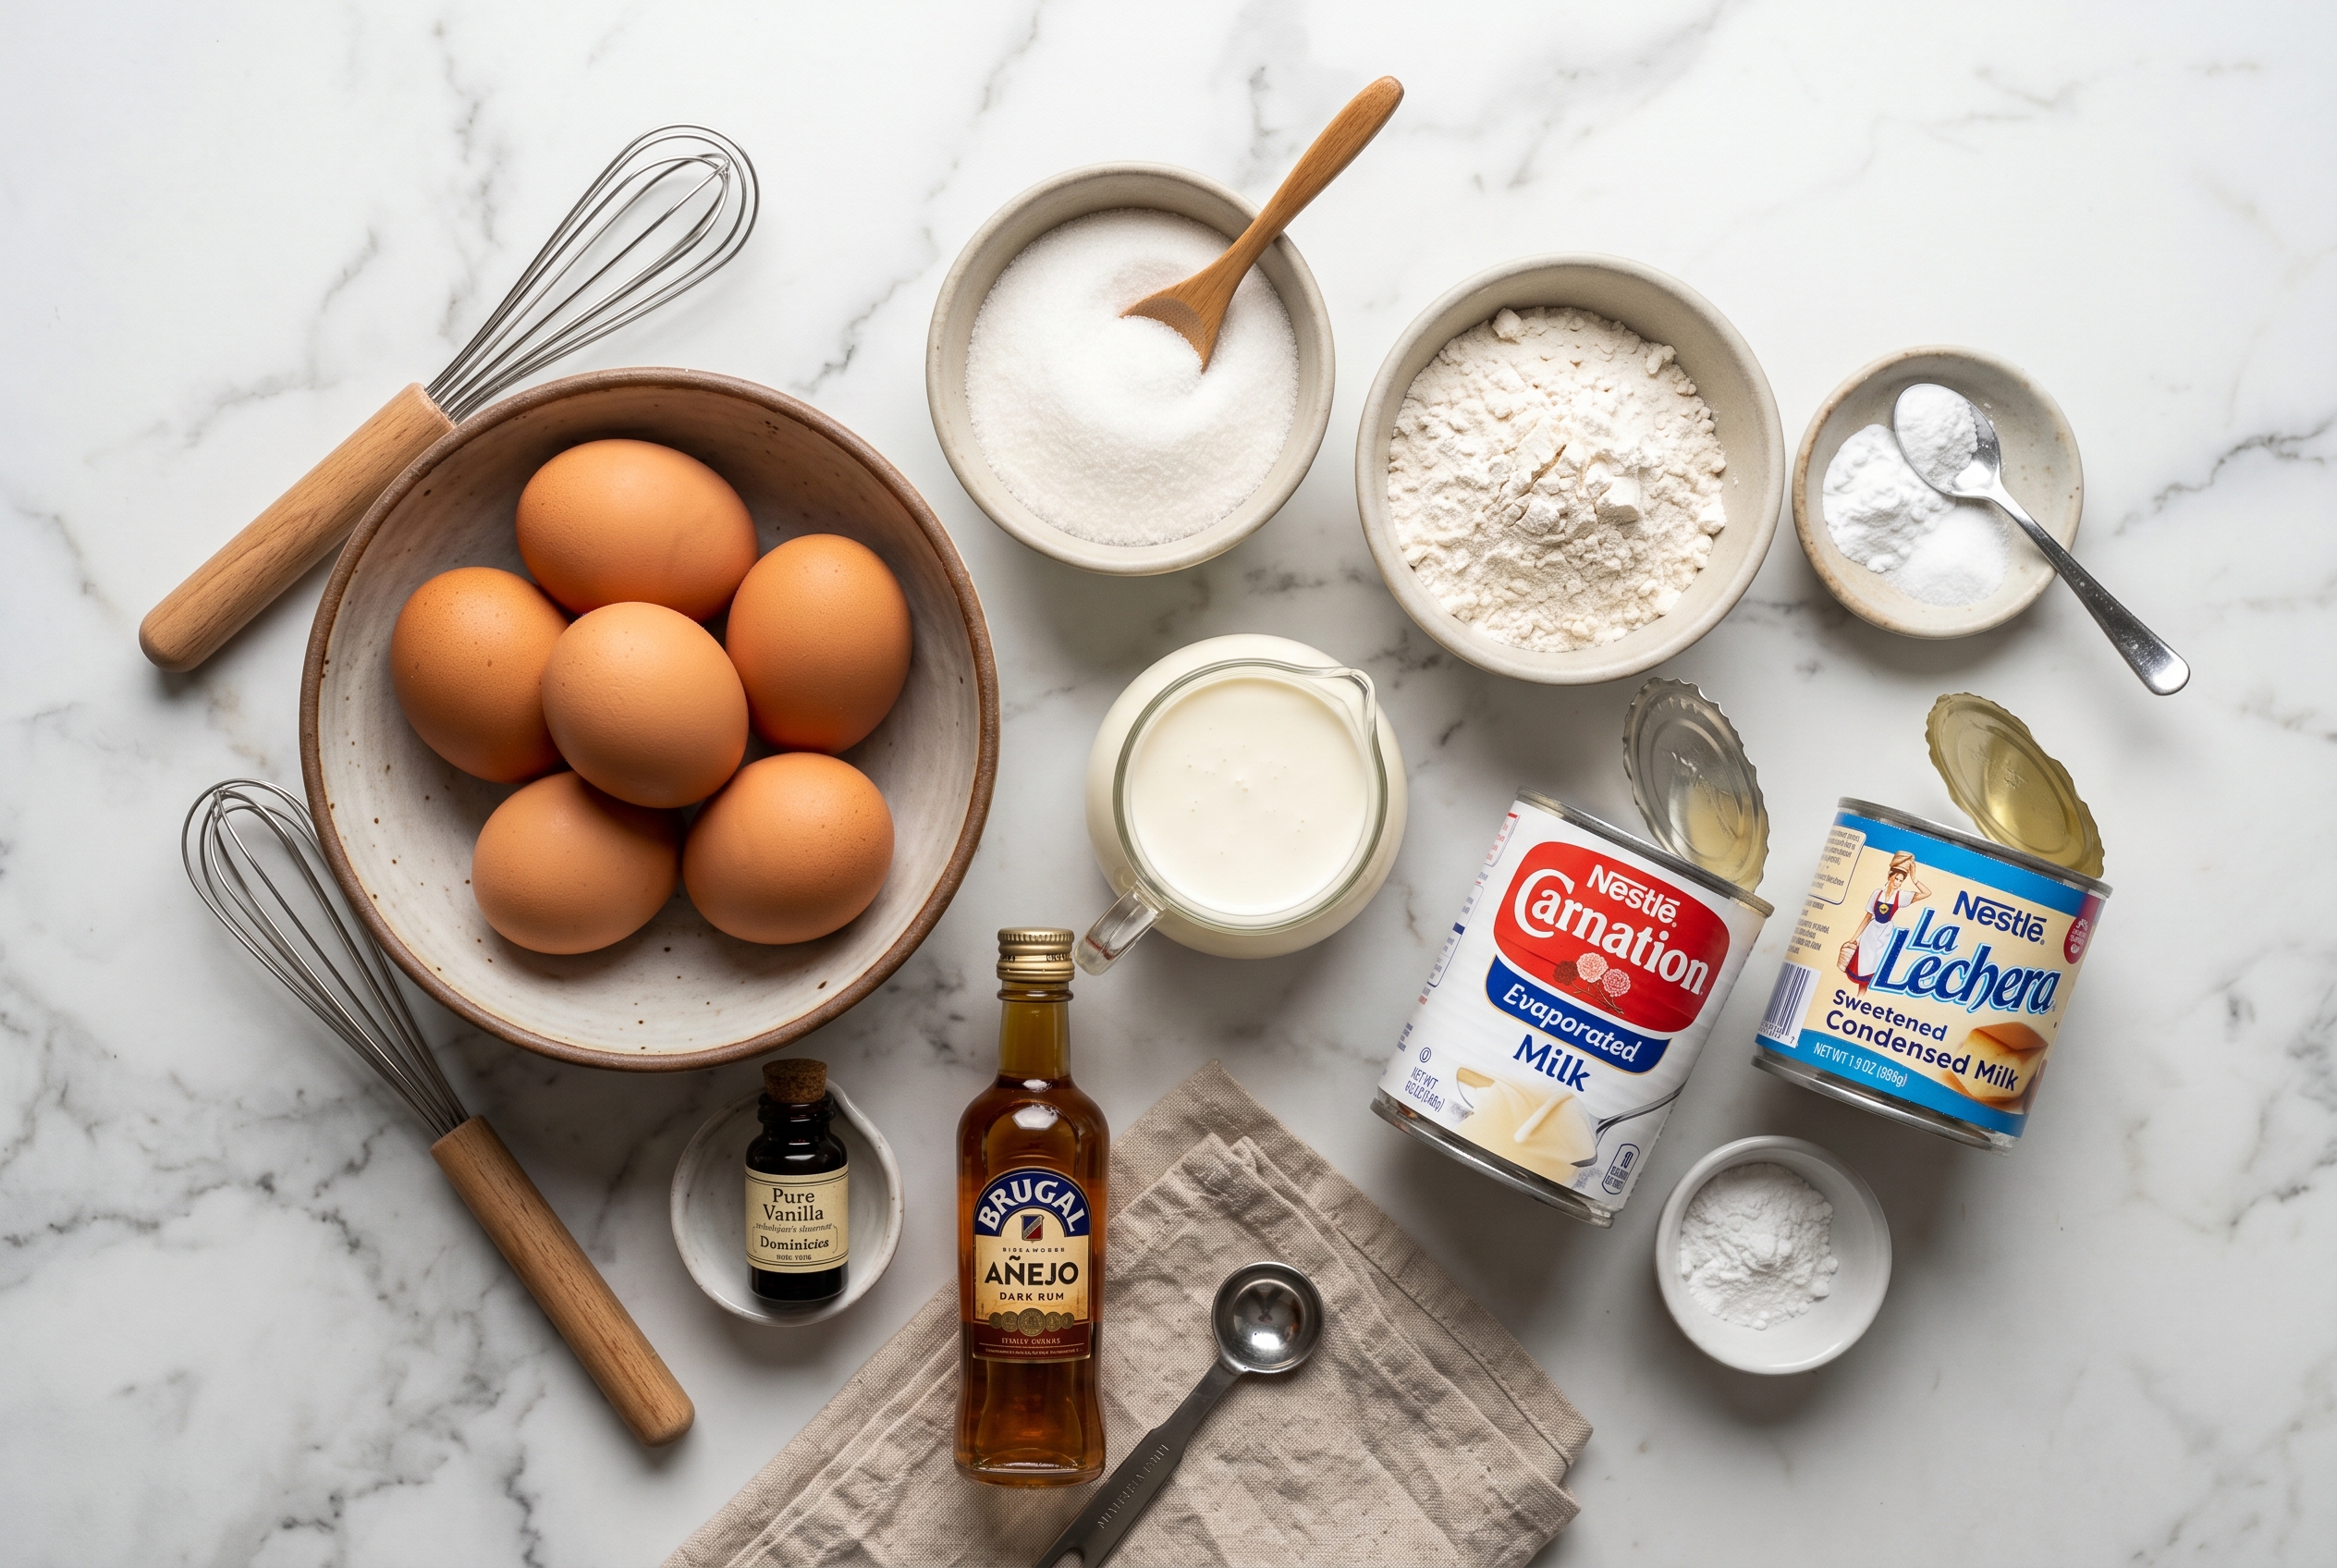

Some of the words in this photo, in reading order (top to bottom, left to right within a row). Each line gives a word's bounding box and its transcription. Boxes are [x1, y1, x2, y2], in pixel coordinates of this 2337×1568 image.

[1514, 868, 1709, 996] Carnation
[1907, 906, 1965, 954] La
[1869, 927, 2062, 1014] Lechera
[1502, 983, 1642, 1063] Evaporated
[1832, 989, 1948, 1042] Sweetened
[1512, 1034, 1591, 1093] Milk
[1813, 1042, 1833, 1059] NET
[1831, 1047, 1849, 1064] WT
[1862, 1060, 1878, 1075] OZ
[1826, 1010, 1971, 1076] Condensed
[1974, 1060, 2019, 1092] Milk
[763, 1204, 824, 1221] Vanilla
[772, 1187, 815, 1204] Pure
[978, 1178, 1085, 1232] BRUGAL
[984, 1255, 1079, 1286] AÑEJO
[999, 1292, 1033, 1301] DARK
[1038, 1292, 1064, 1301] RUM
